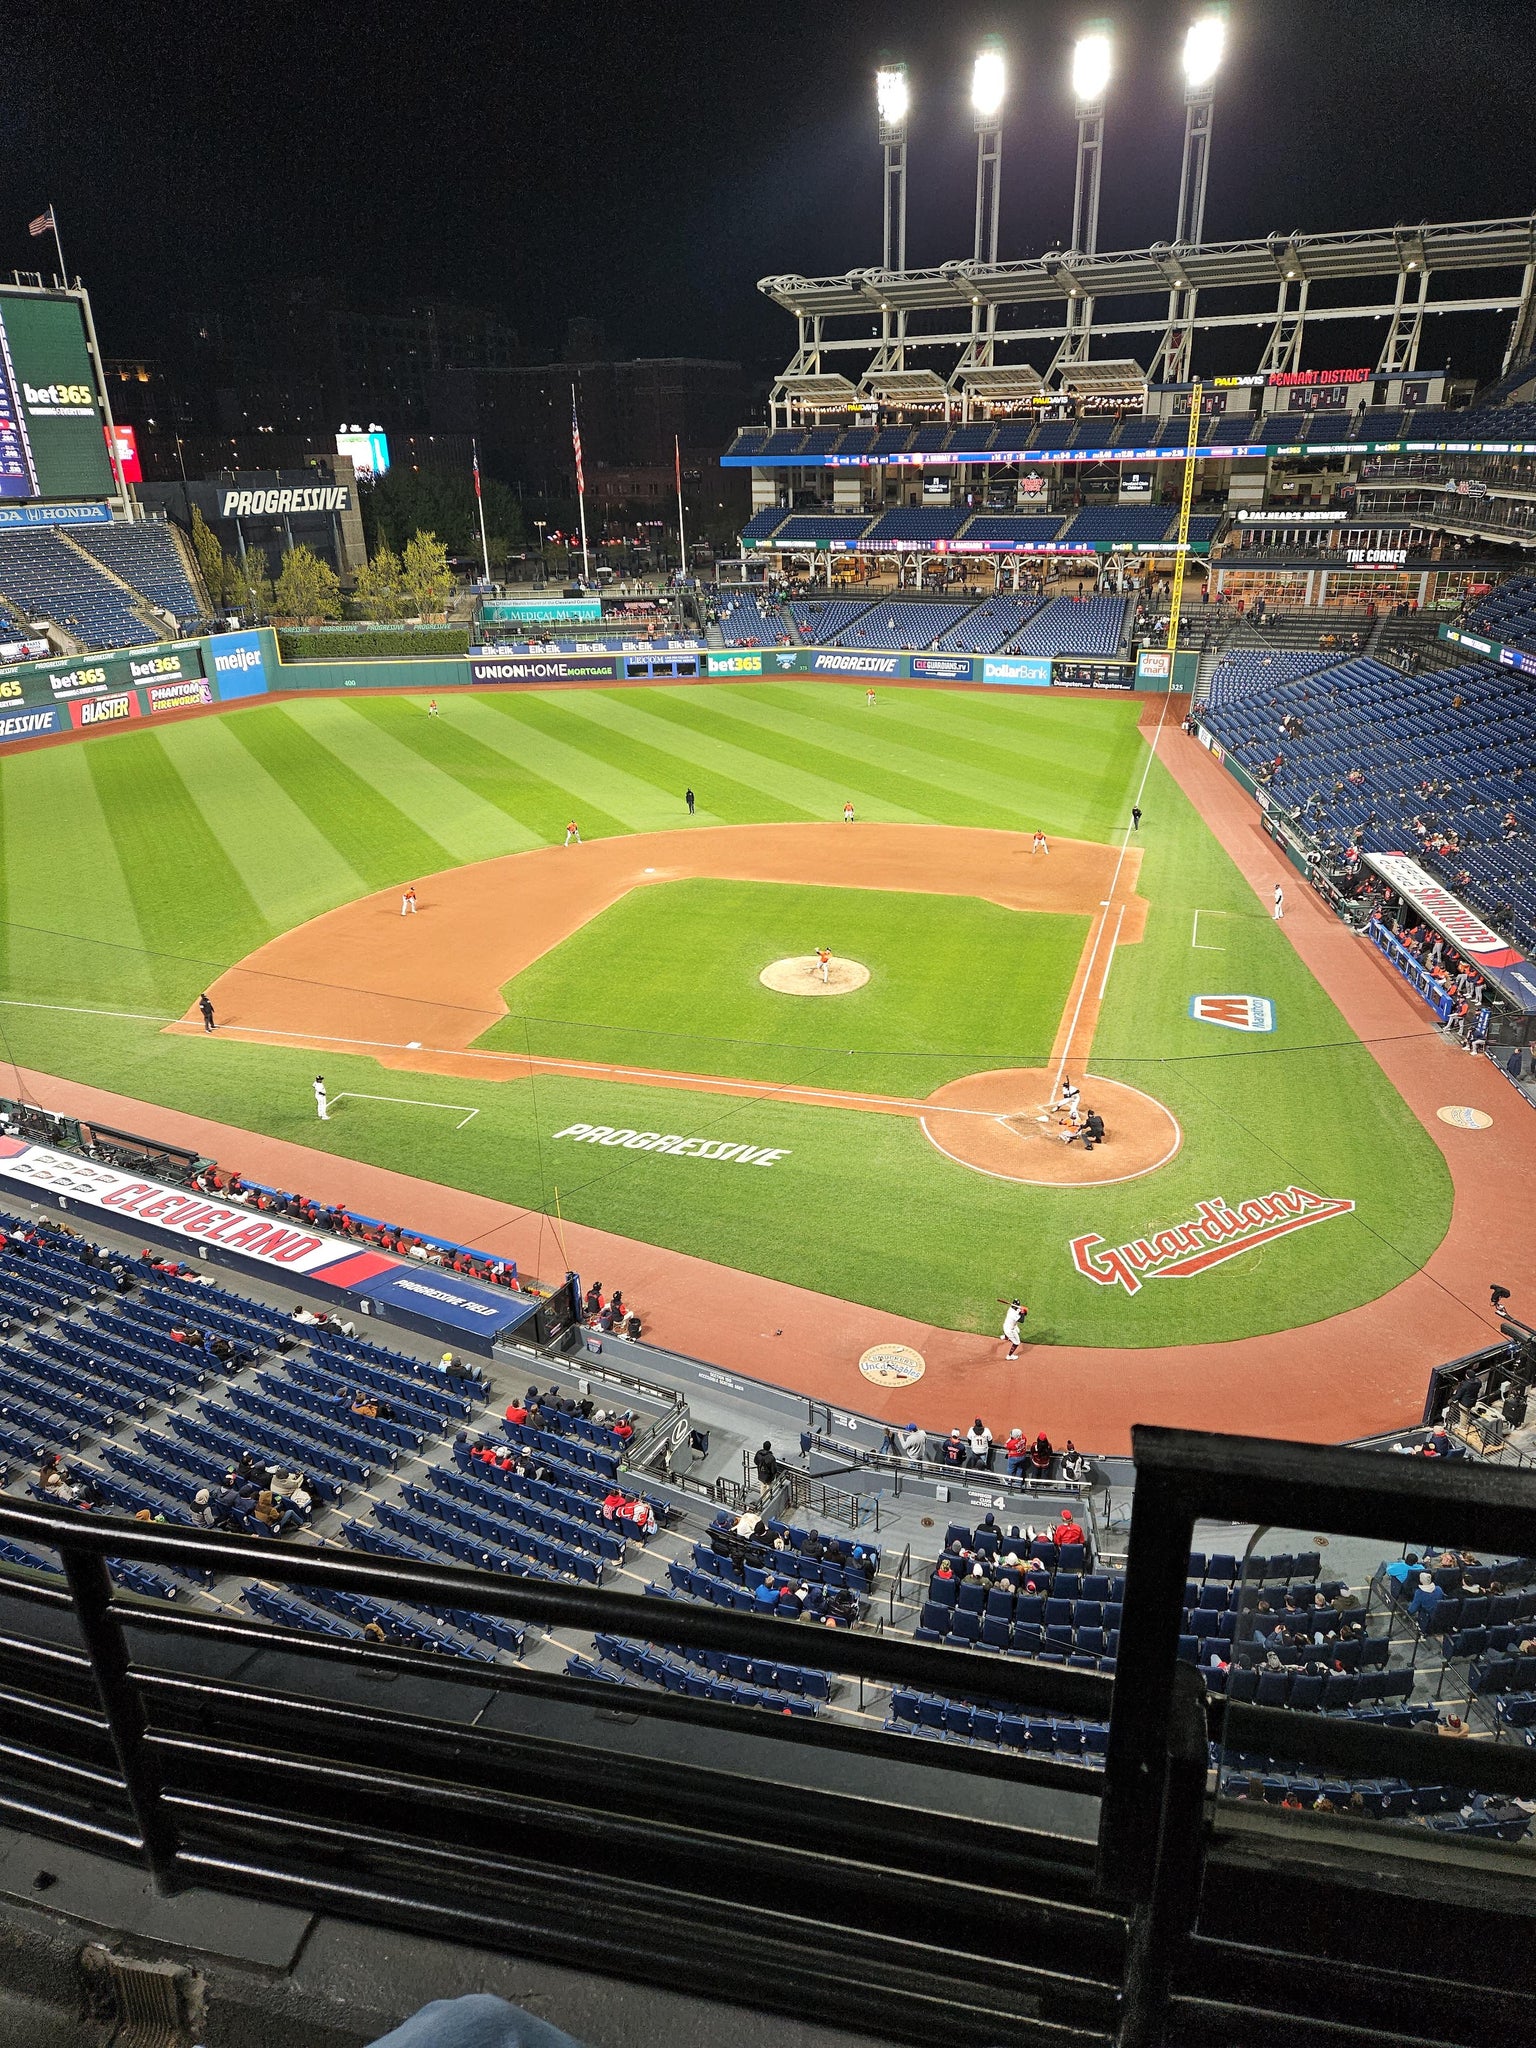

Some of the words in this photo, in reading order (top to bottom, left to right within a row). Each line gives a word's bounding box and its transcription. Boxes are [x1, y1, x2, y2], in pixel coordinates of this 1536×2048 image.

[1268, 370, 1319, 386] PENNANT
[1321, 368, 1371, 384] DISTRICT
[22, 382, 93, 405] bet365
[223, 487, 348, 517] PROGRESSIVE
[42, 506, 104, 520] HONDA
[1347, 549, 1365, 563] THE
[1366, 549, 1407, 564] CORNER
[511, 610, 551, 620] MEDICAL
[413, 623, 450, 631] PROGRESSIVE
[130, 656, 181, 677] bet365
[214, 647, 262, 672] meijer
[708, 656, 762, 671] bet365
[815, 655, 899, 673] PROGRESSIVE
[1142, 654, 1165, 667] drug
[49, 668, 106, 690] bet365
[567, 666, 612, 676] MORTGAGE
[1143, 666, 1168, 675] mart
[151, 681, 200, 700] PHANTOM
[81, 697, 130, 724] BLASTER
[152, 694, 201, 711] FIREWORKS
[1409, 887, 1498, 944] GUARDIANS
[551, 1122, 793, 1167] PROGRESSIVE
[100, 1183, 323, 1262] CLEVELAND
[1070, 1185, 1355, 1296] Guardians
[392, 1279, 468, 1306] PROGRESSIVE
[460, 1300, 500, 1316] FIELD
[848, 1418, 858, 1431] 6
[993, 1496, 1006, 1511] 4
